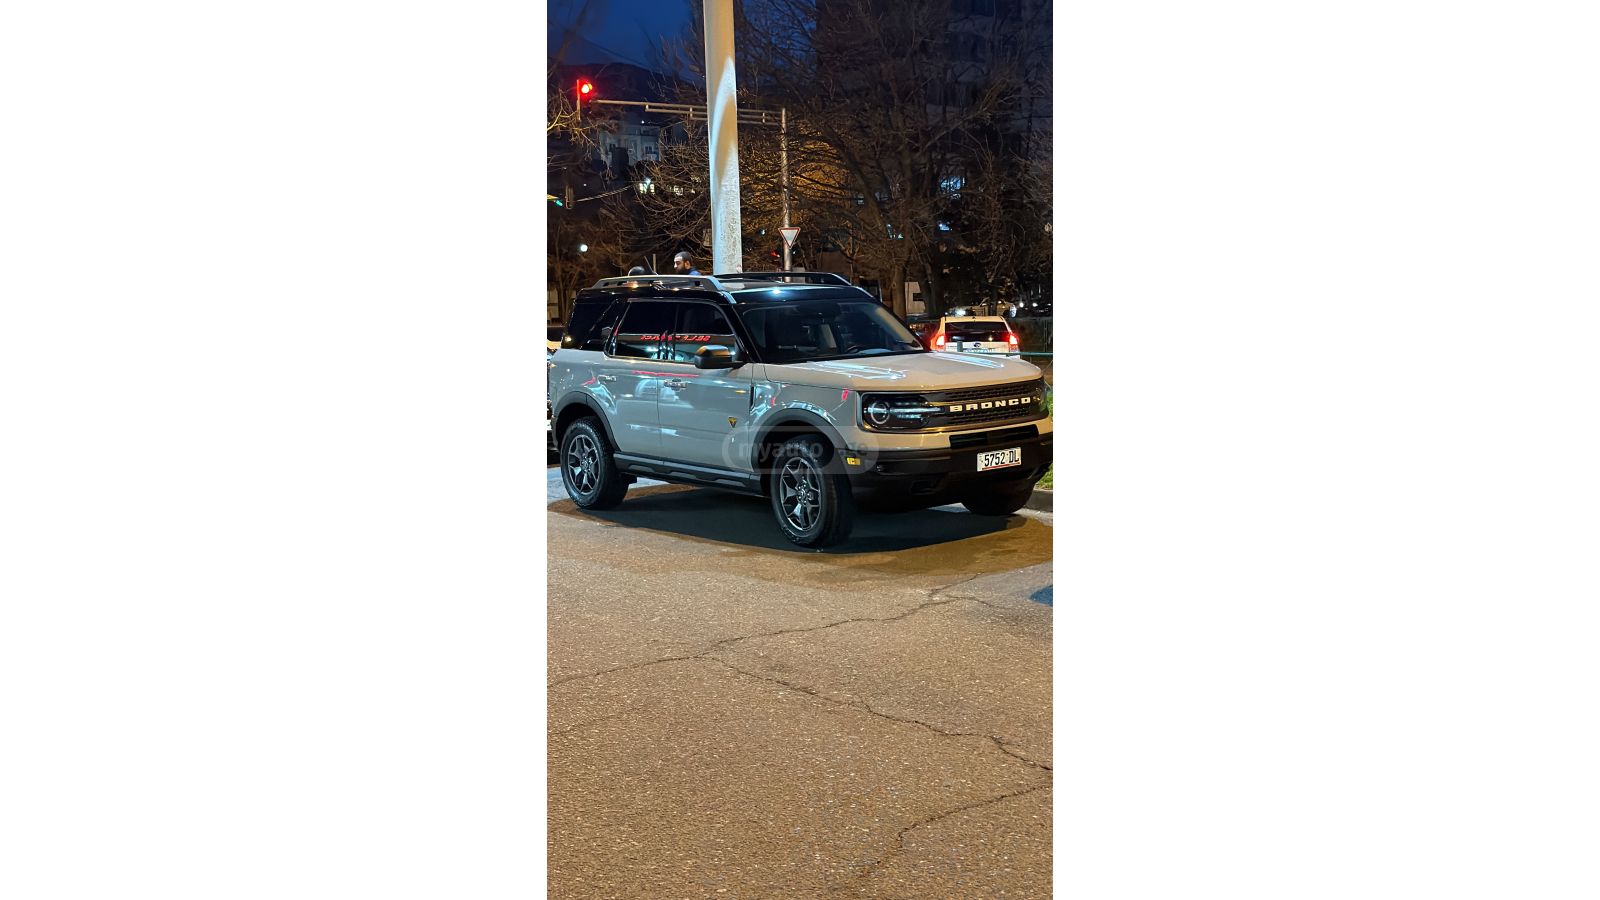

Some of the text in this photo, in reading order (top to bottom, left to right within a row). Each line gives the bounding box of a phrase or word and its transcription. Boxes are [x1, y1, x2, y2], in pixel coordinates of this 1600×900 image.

[949, 396, 1031, 412] BRONCO
[984, 449, 1020, 467] 5752 DL
